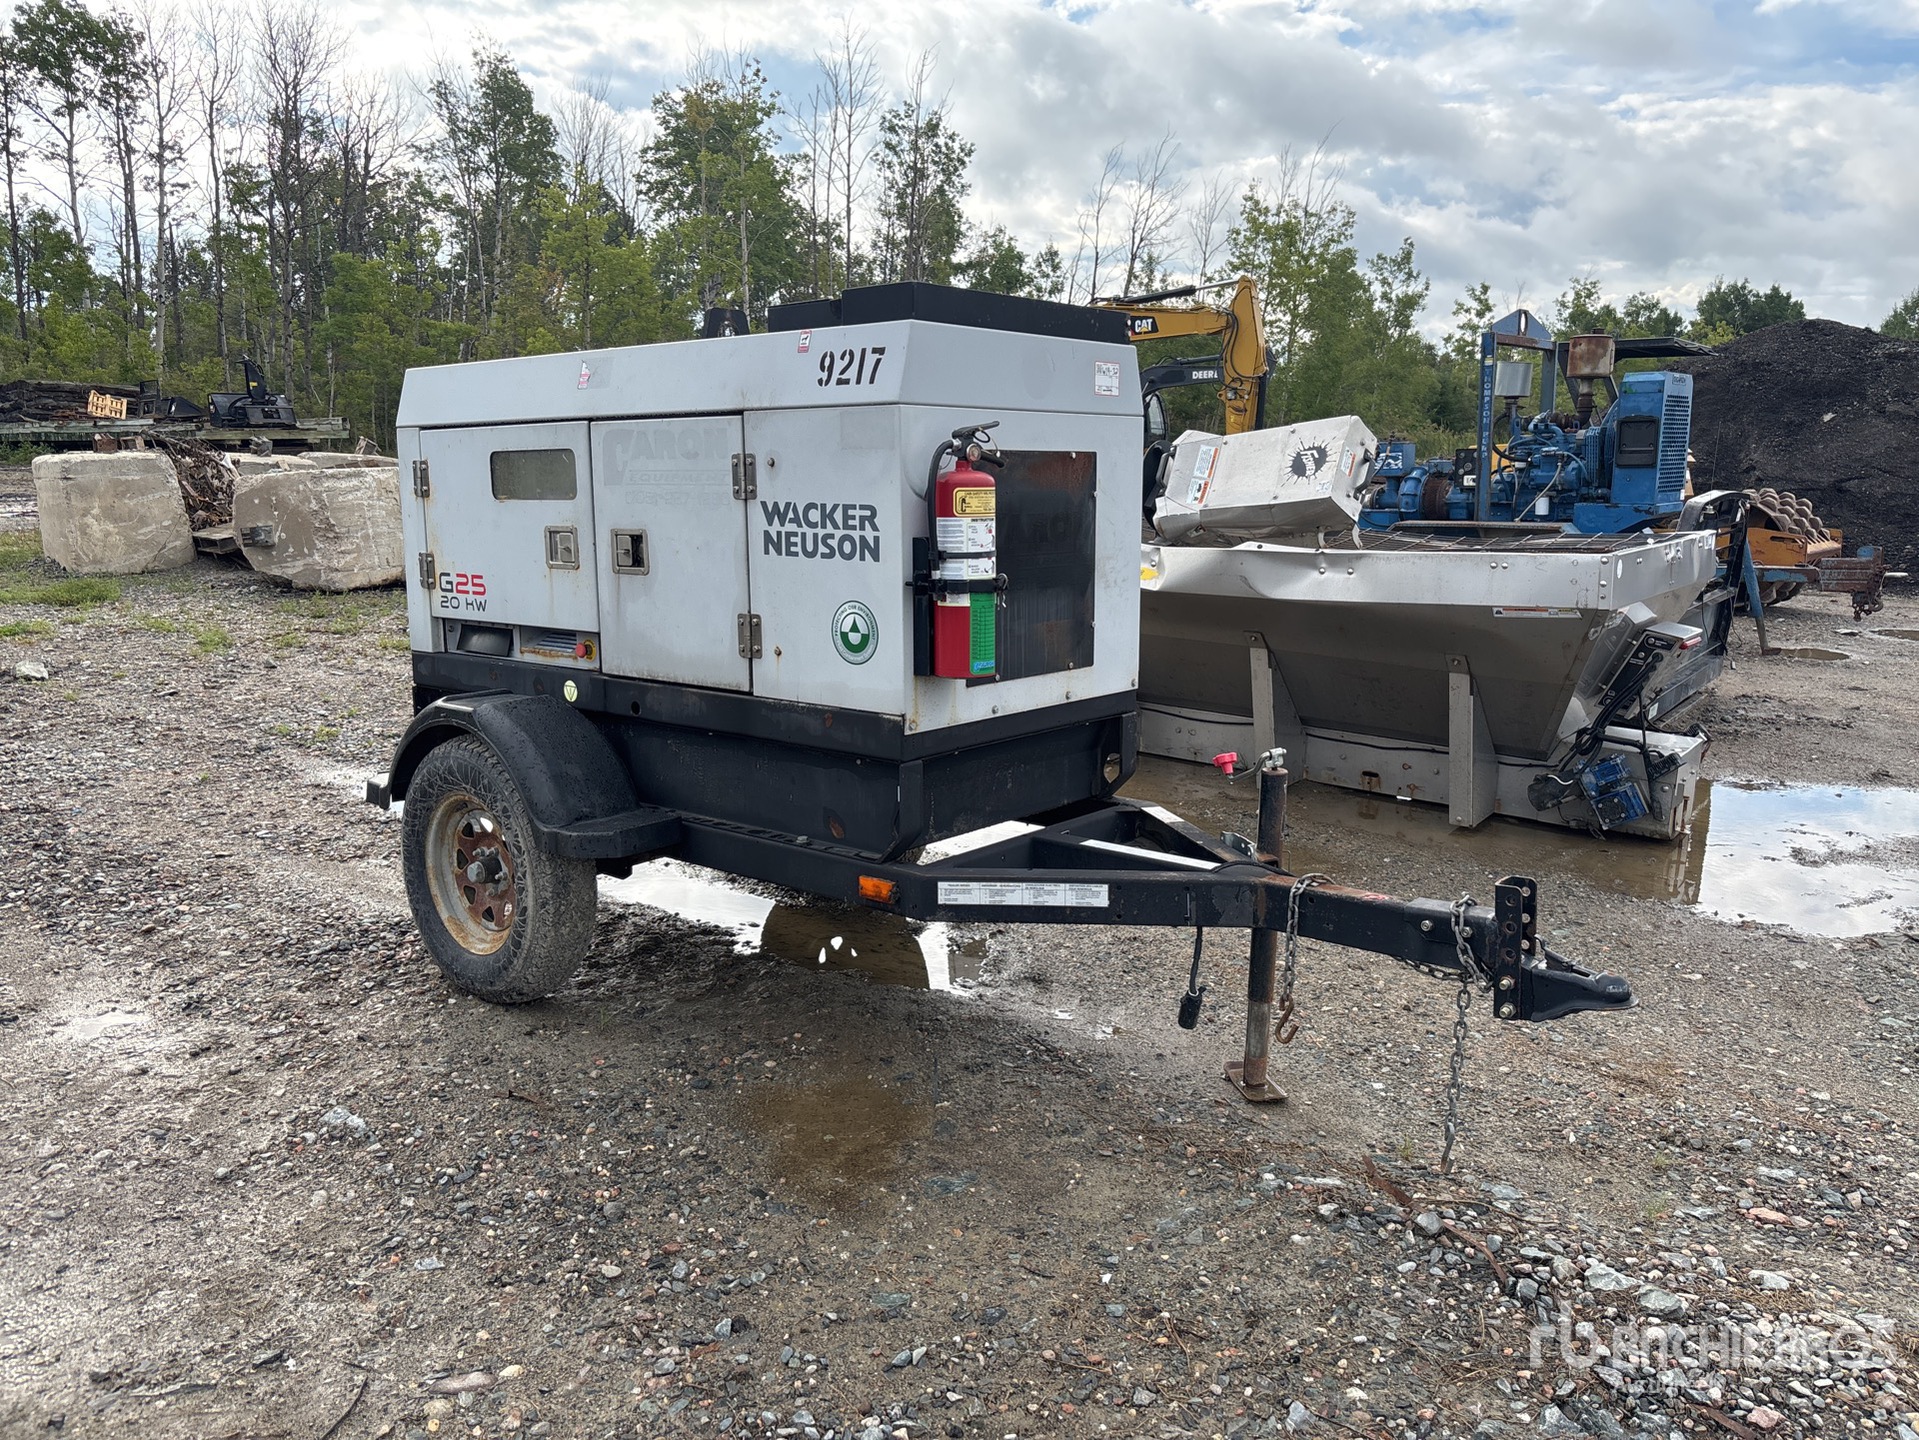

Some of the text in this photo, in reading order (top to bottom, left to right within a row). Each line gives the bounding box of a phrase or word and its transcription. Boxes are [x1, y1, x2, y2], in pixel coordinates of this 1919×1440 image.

[1135, 319, 1153, 333] CAT
[817, 346, 886, 387] 9217
[760, 501, 880, 532] WACKER
[763, 530, 880, 562] NEUSON
[439, 572, 486, 596] G25
[440, 595, 460, 609] 20
